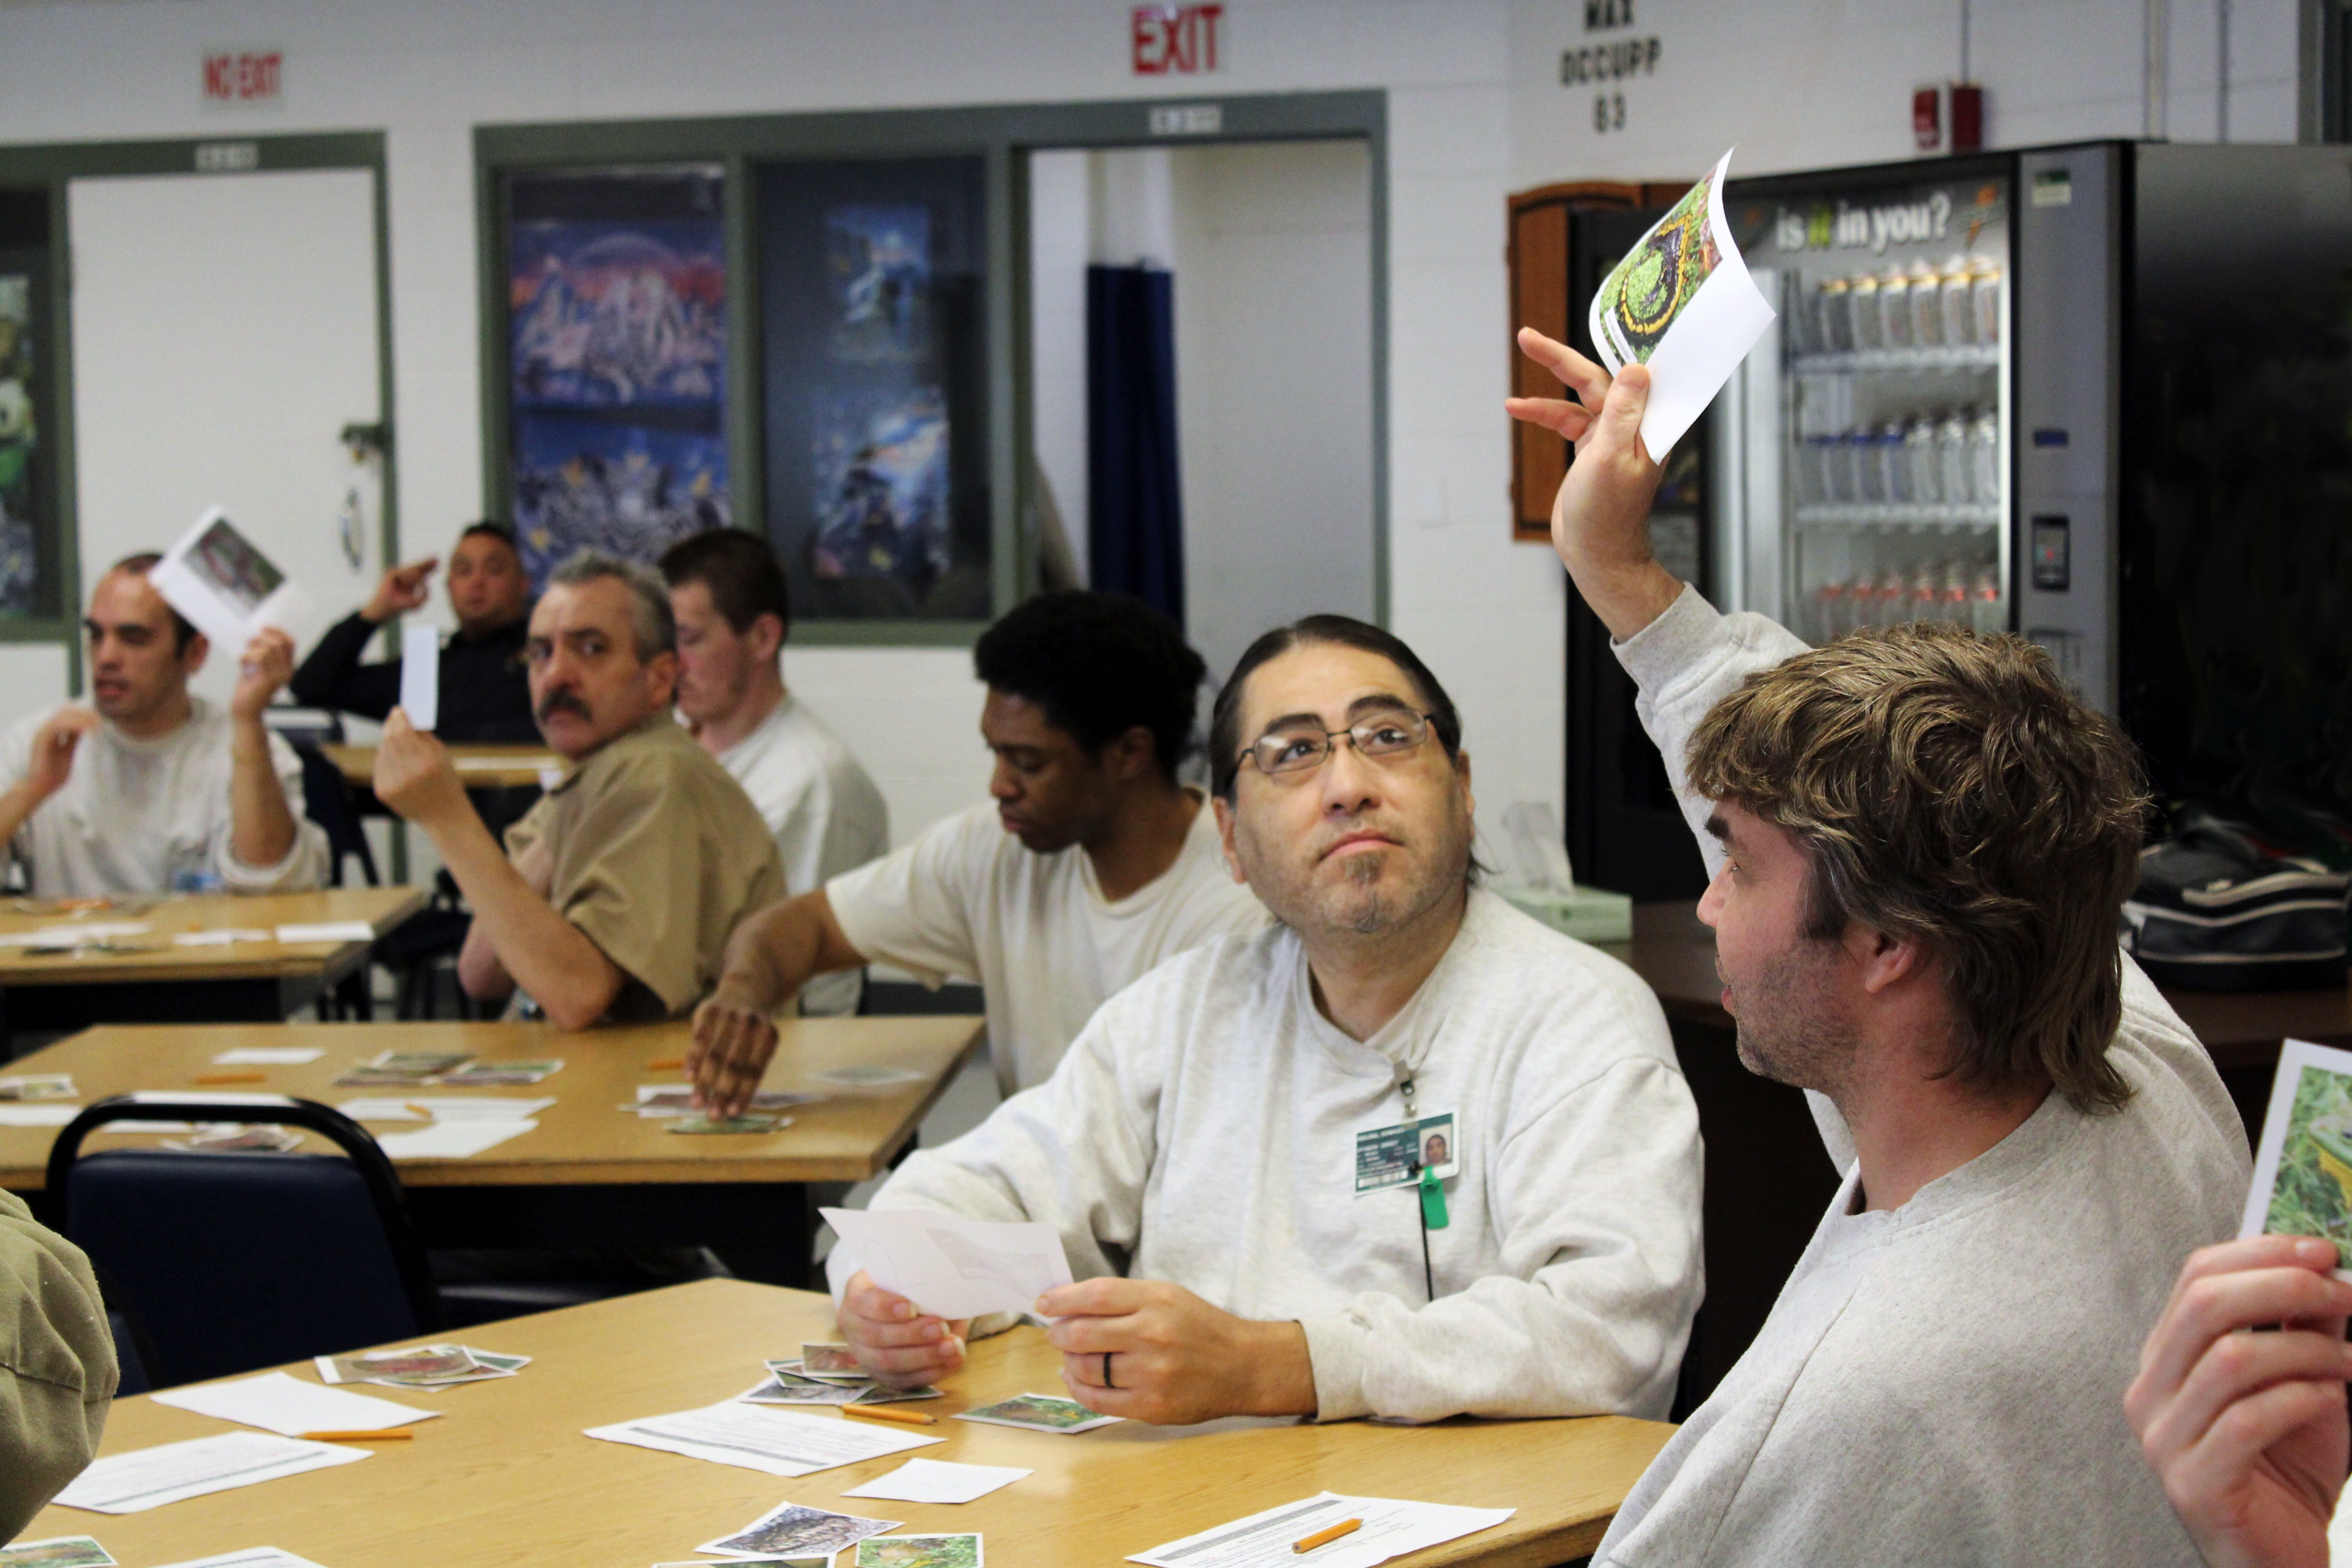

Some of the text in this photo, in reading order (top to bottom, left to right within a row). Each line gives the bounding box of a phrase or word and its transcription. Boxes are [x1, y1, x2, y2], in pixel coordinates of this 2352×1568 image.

[1132, 6, 1222, 75] EXIT
[1585, 0, 1633, 31] MAX
[203, 51, 284, 100] NO EXIT
[1777, 206, 1805, 252] is
[1836, 200, 1870, 246] in
[1871, 192, 1951, 255] you?
